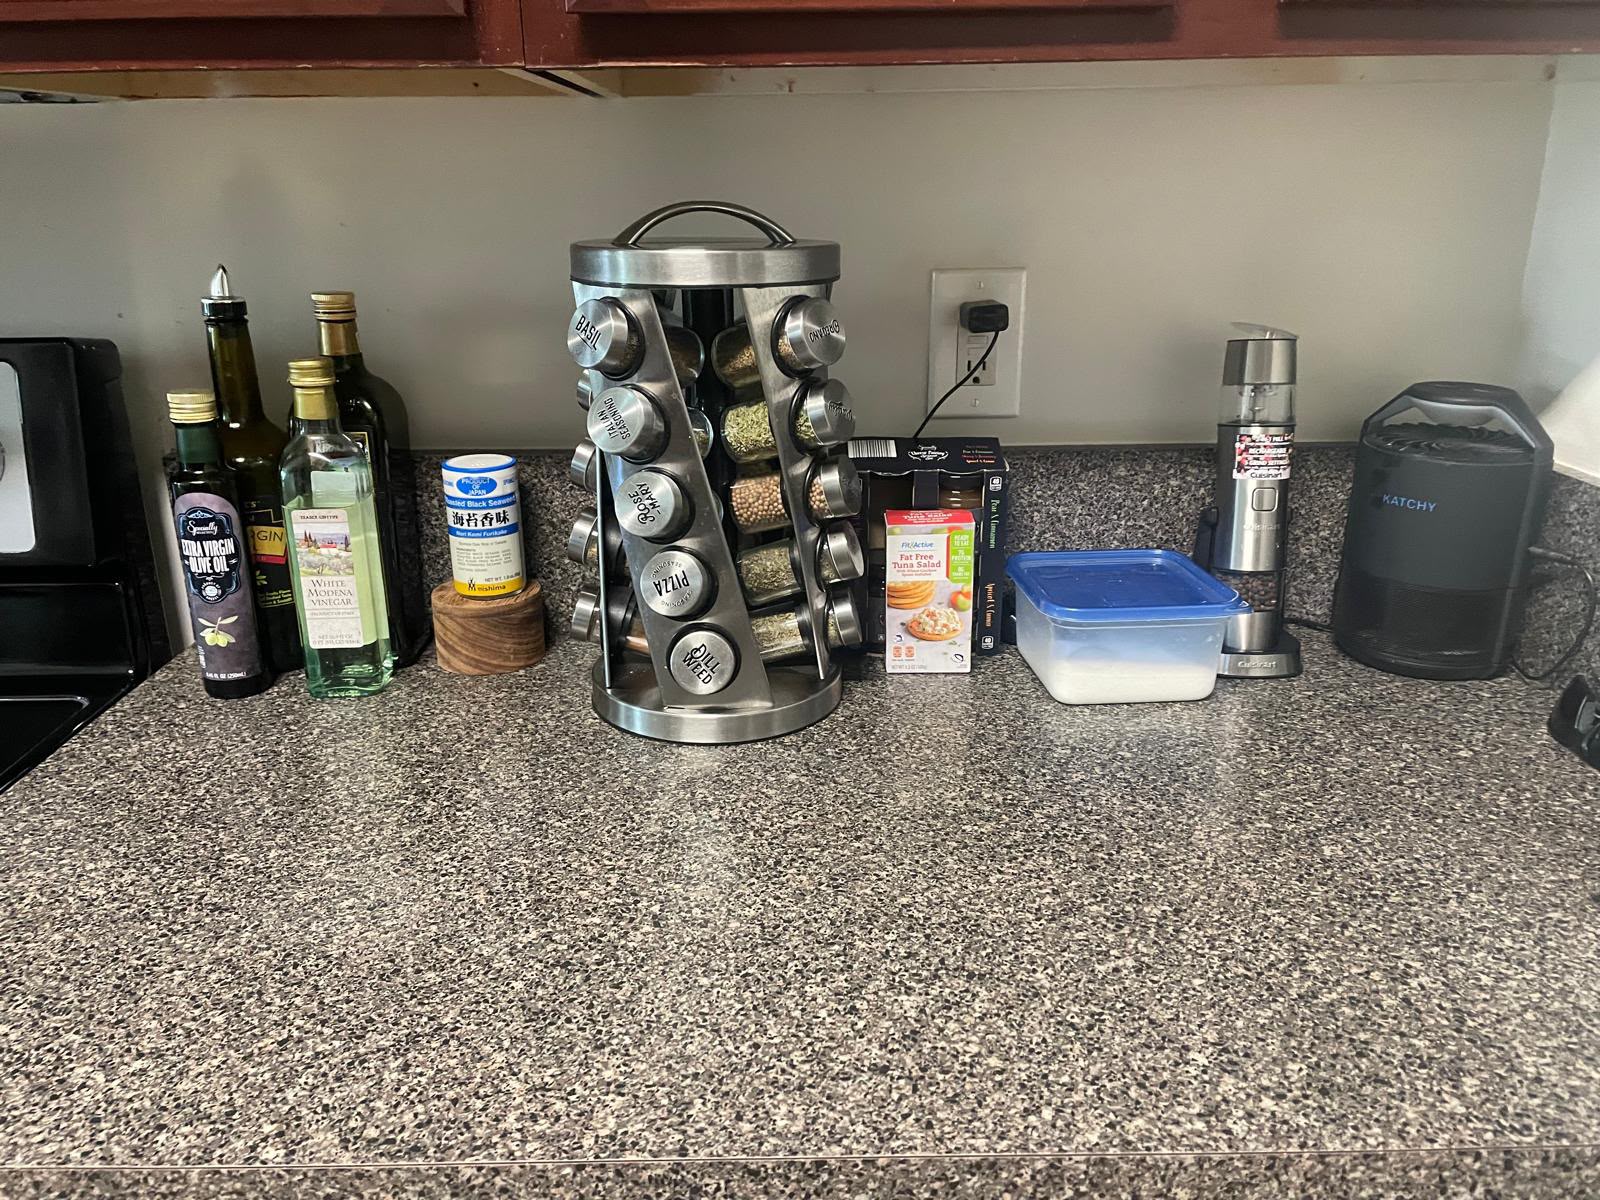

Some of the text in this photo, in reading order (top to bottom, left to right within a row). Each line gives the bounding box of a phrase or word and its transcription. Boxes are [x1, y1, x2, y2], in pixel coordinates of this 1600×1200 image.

[576, 315, 602, 350] BASIL
[809, 320, 840, 342] OREGANO
[598, 410, 619, 438] ITALIAN
[604, 398, 631, 440] SEASONING
[629, 492, 655, 524] ROSE
[1383, 494, 1436, 512] KATCHY
[452, 510, 509, 527] 海苔香味
[181, 538, 235, 557] EXTRA VIRGIN
[189, 556, 229, 573] OLIVE OIL
[916, 560, 941, 568] Salad
[308, 589, 352, 597] MODENA
[653, 570, 690, 596] PIZZA
[683, 652, 713, 685] WEED
[691, 643, 721, 674] DILL
